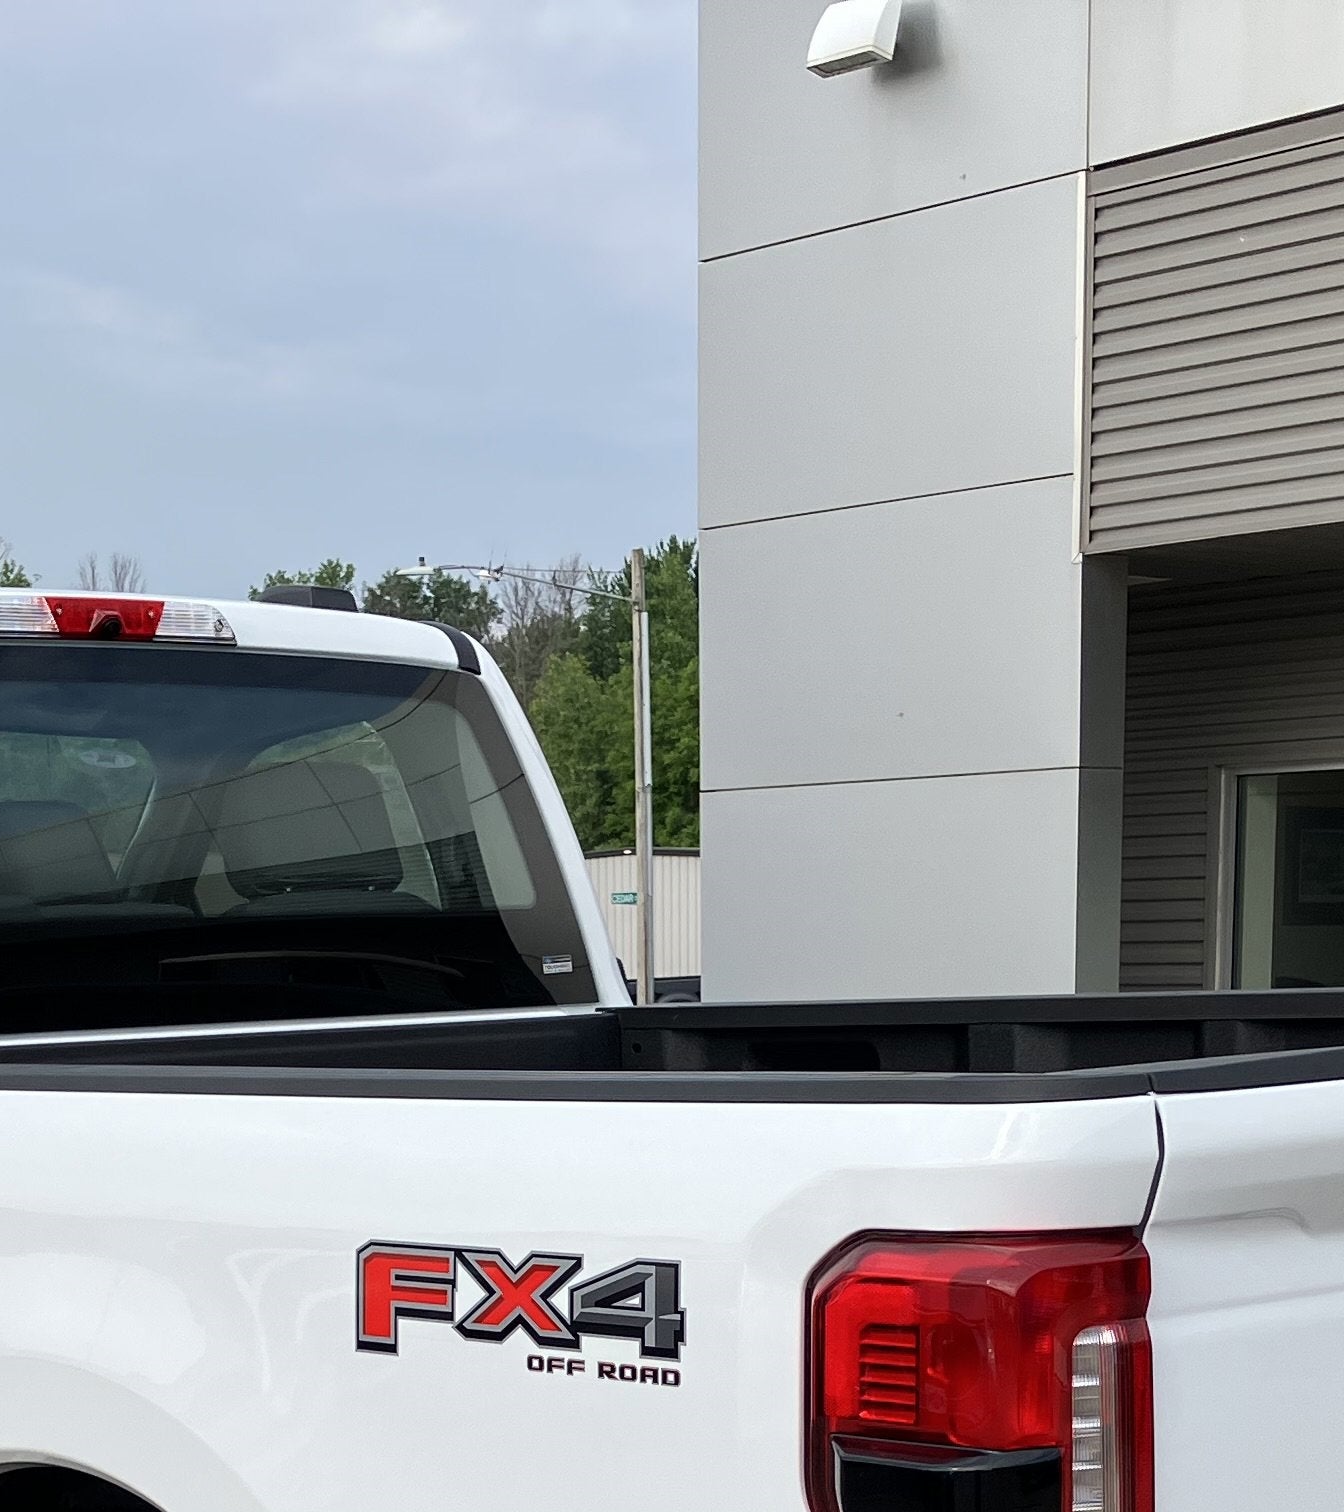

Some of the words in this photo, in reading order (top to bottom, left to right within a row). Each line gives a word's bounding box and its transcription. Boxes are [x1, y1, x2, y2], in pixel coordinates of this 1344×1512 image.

[355, 1239, 687, 1362] FX4
[526, 1353, 586, 1377] OFF
[597, 1361, 682, 1388] ROAD
